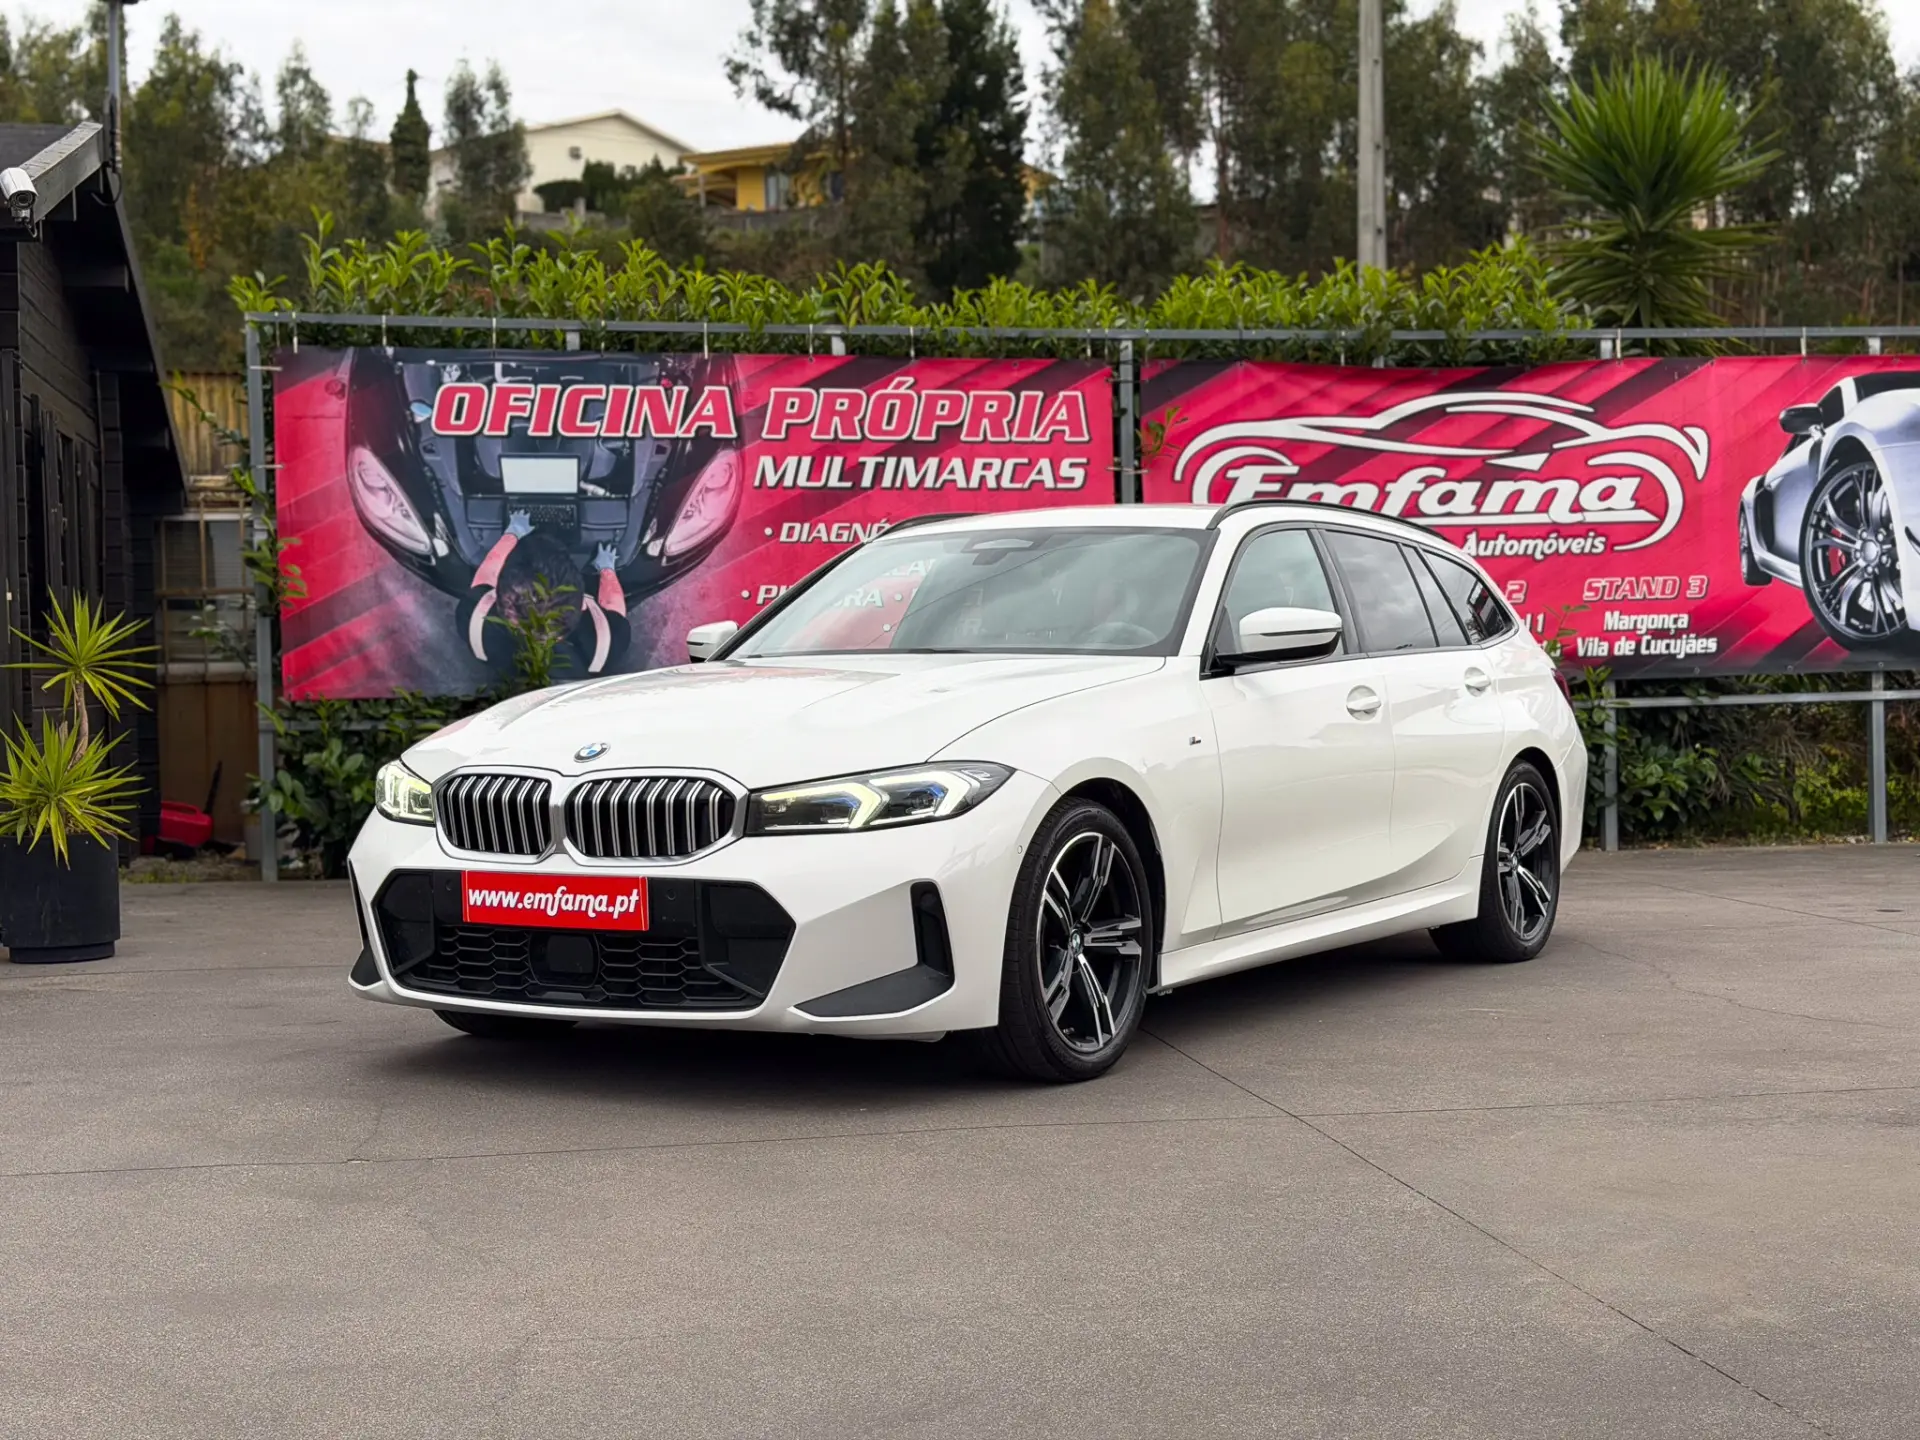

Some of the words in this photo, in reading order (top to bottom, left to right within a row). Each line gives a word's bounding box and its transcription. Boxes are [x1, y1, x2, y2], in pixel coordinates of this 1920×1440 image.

[432, 382, 738, 438] OFICINA
[761, 377, 1091, 442] PRÓPRIA
[753, 455, 1088, 490] MULTIMARCAS
[1462, 531, 1607, 561] Automóveis
[1582, 576, 1680, 601] STAND
[1686, 575, 1708, 598] 3
[1603, 610, 1690, 635] Margonça
[1576, 637, 1610, 657] Vila
[1613, 636, 1636, 656] de
[1640, 634, 1718, 659] Cucujães
[468, 886, 640, 919] www.emfama.pt
